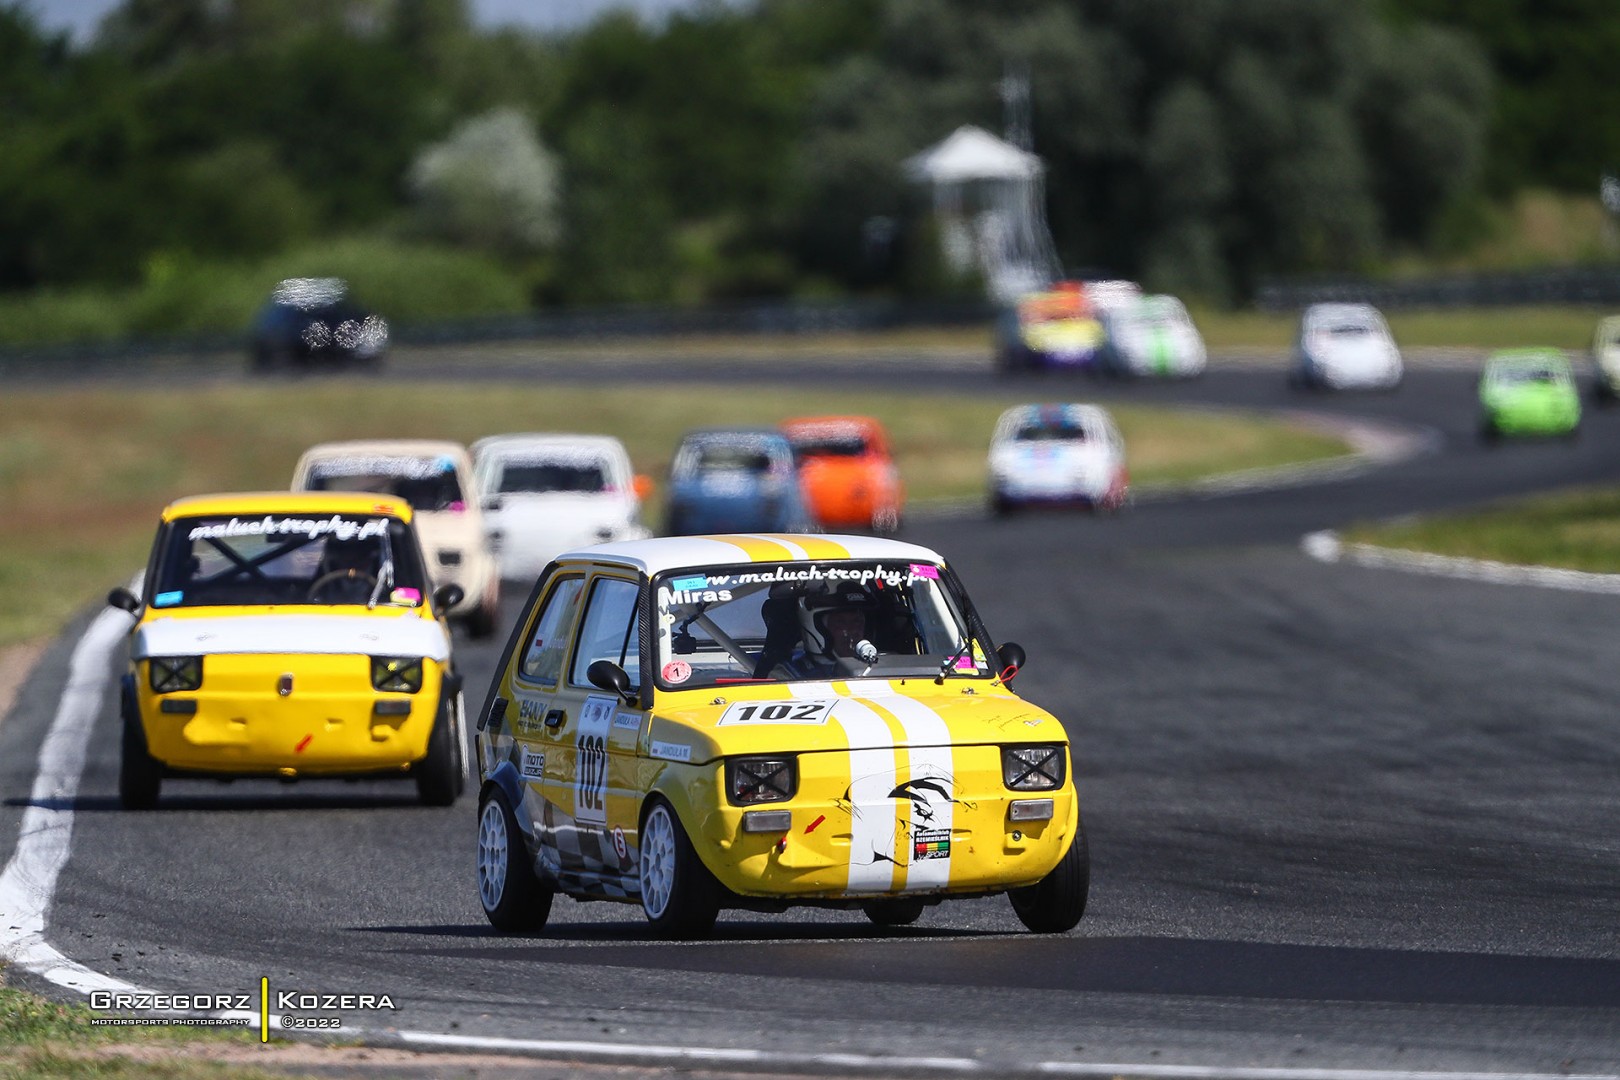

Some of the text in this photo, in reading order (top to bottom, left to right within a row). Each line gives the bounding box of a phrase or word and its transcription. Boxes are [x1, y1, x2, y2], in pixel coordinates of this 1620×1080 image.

[188, 514, 390, 541] maluch-trophy.pl
[663, 589, 733, 605] Miras
[673, 667, 680, 677] 1
[738, 704, 826, 721] 102
[526, 754, 544, 766] MOTO
[577, 735, 606, 811] 102
[926, 850, 949, 858] SPORT
